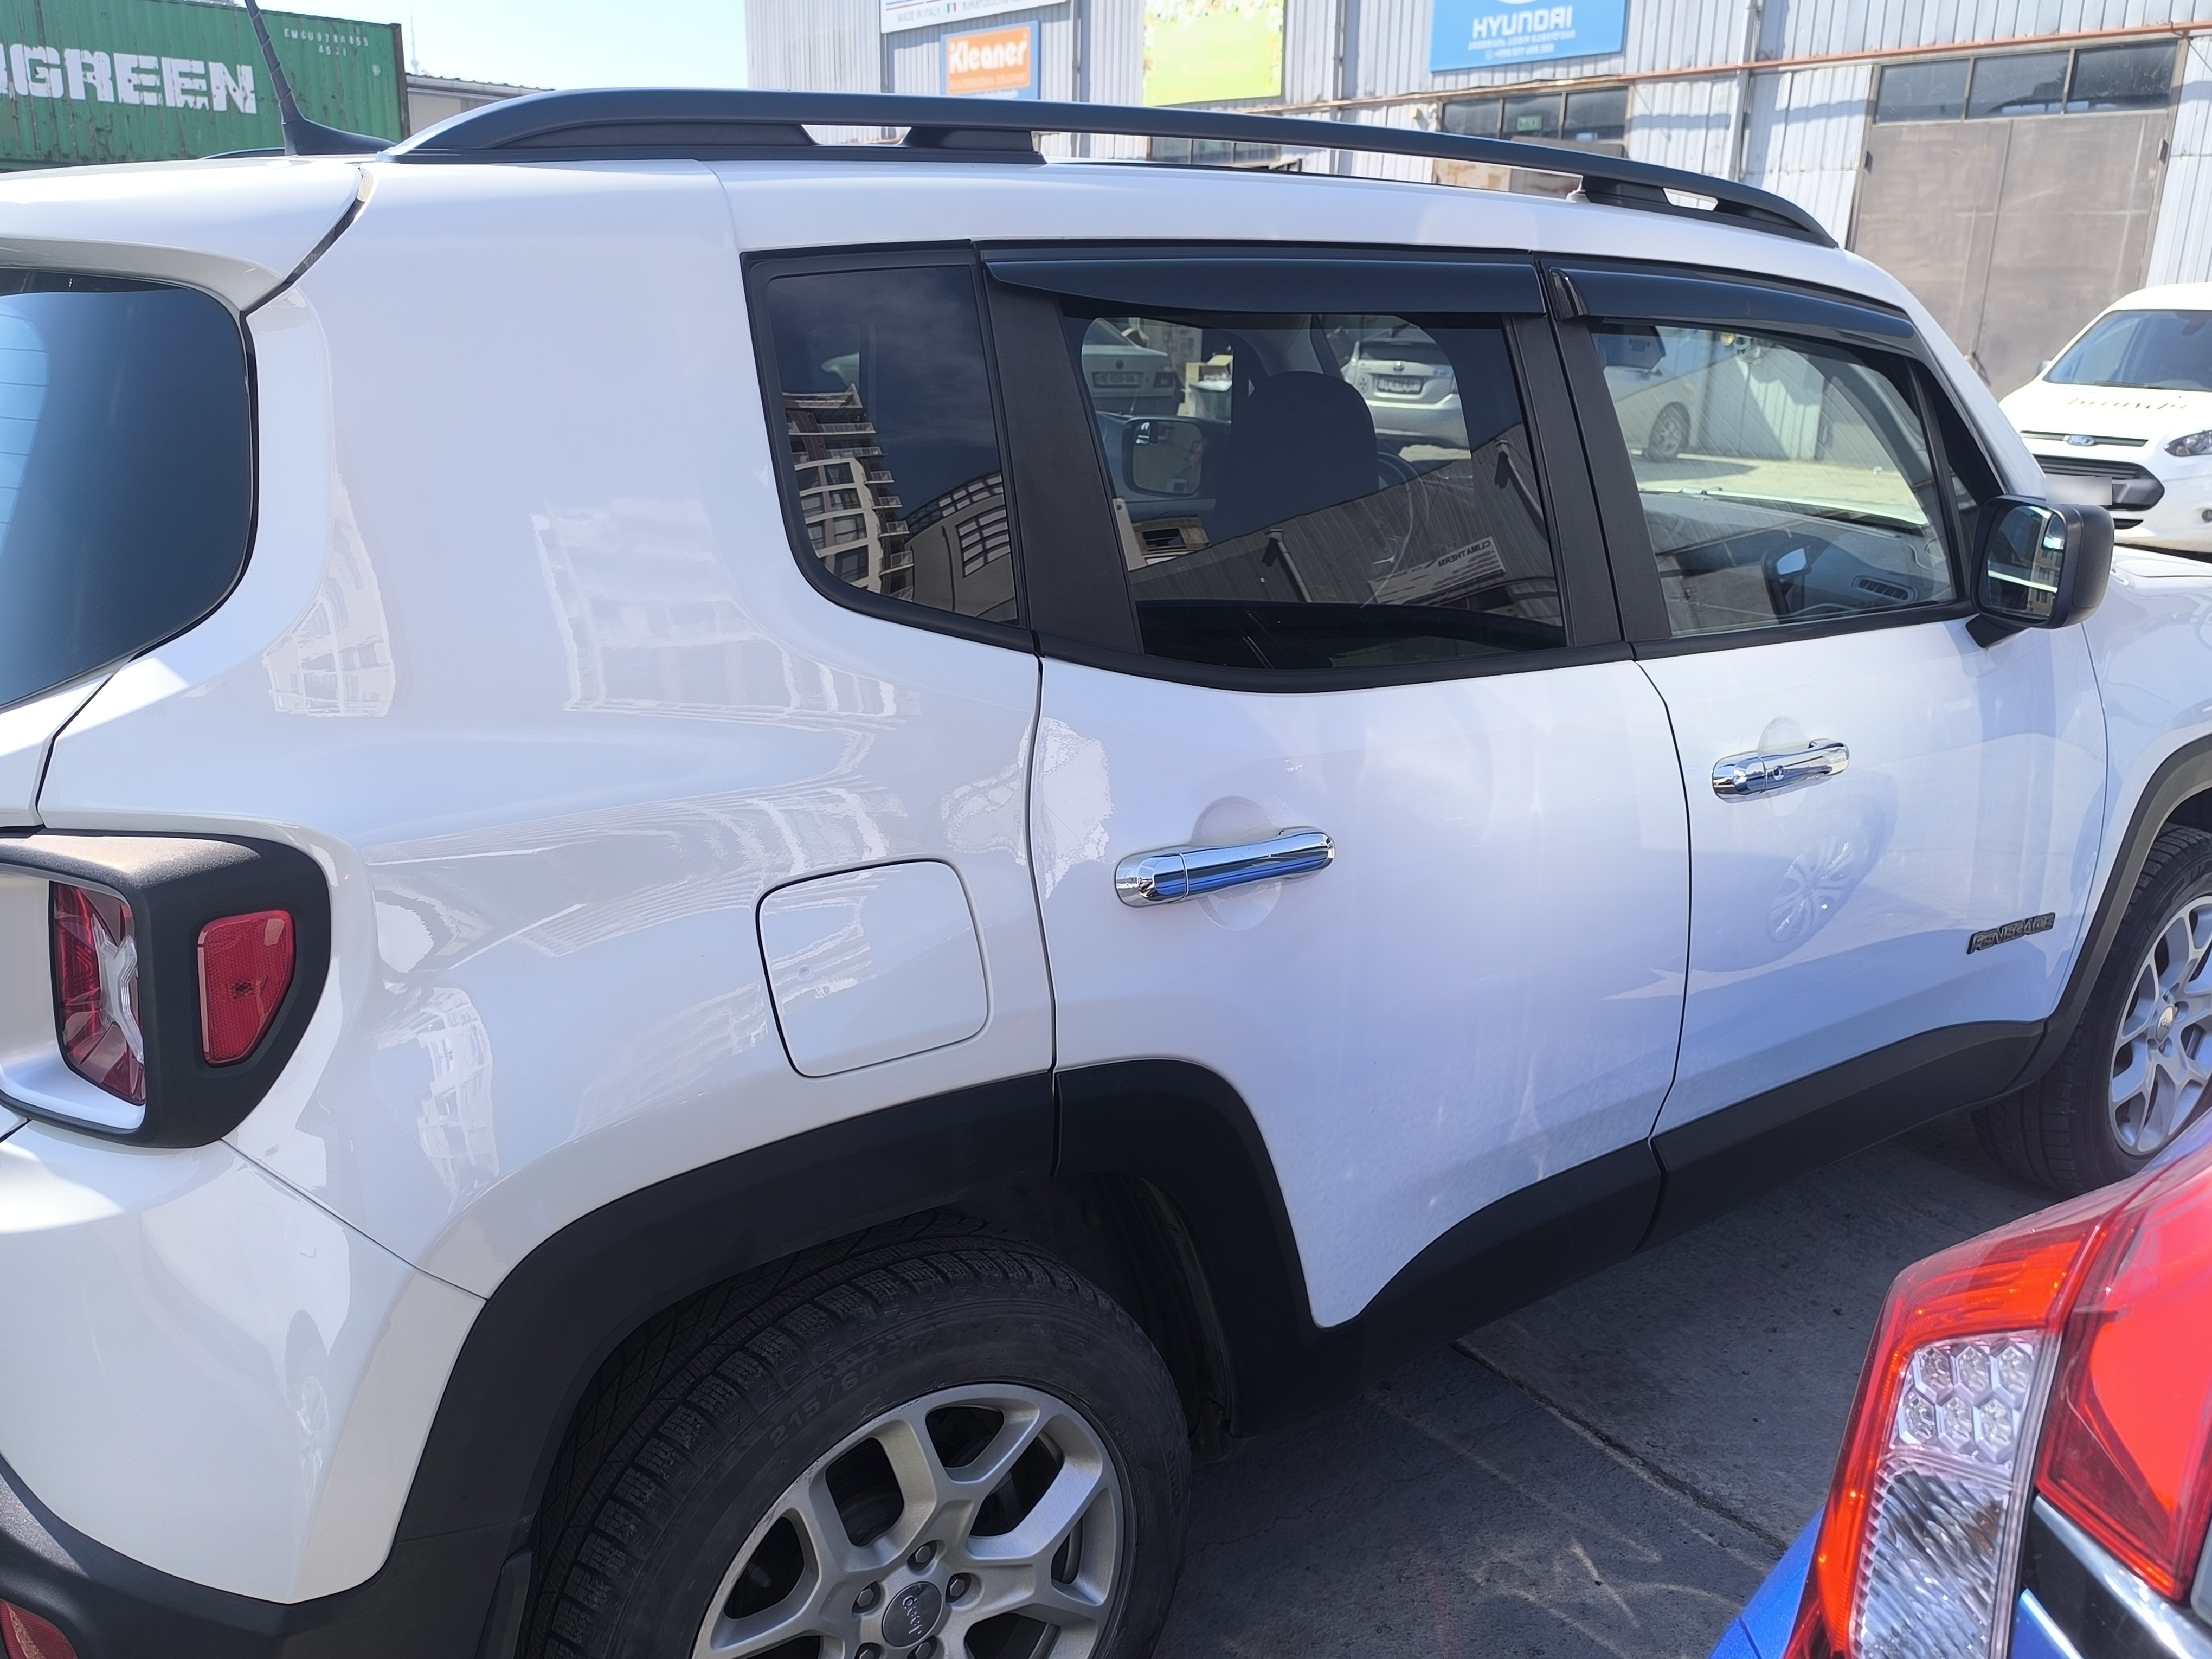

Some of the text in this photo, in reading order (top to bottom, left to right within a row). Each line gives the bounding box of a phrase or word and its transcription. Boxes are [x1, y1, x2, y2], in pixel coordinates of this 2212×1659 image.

[1473, 5, 1573, 40] HYUNDAI
[0, 42, 257, 114] GREEN
[1967, 912, 2055, 954] RENEGADE
[769, 1358, 880, 1449] 215/60
